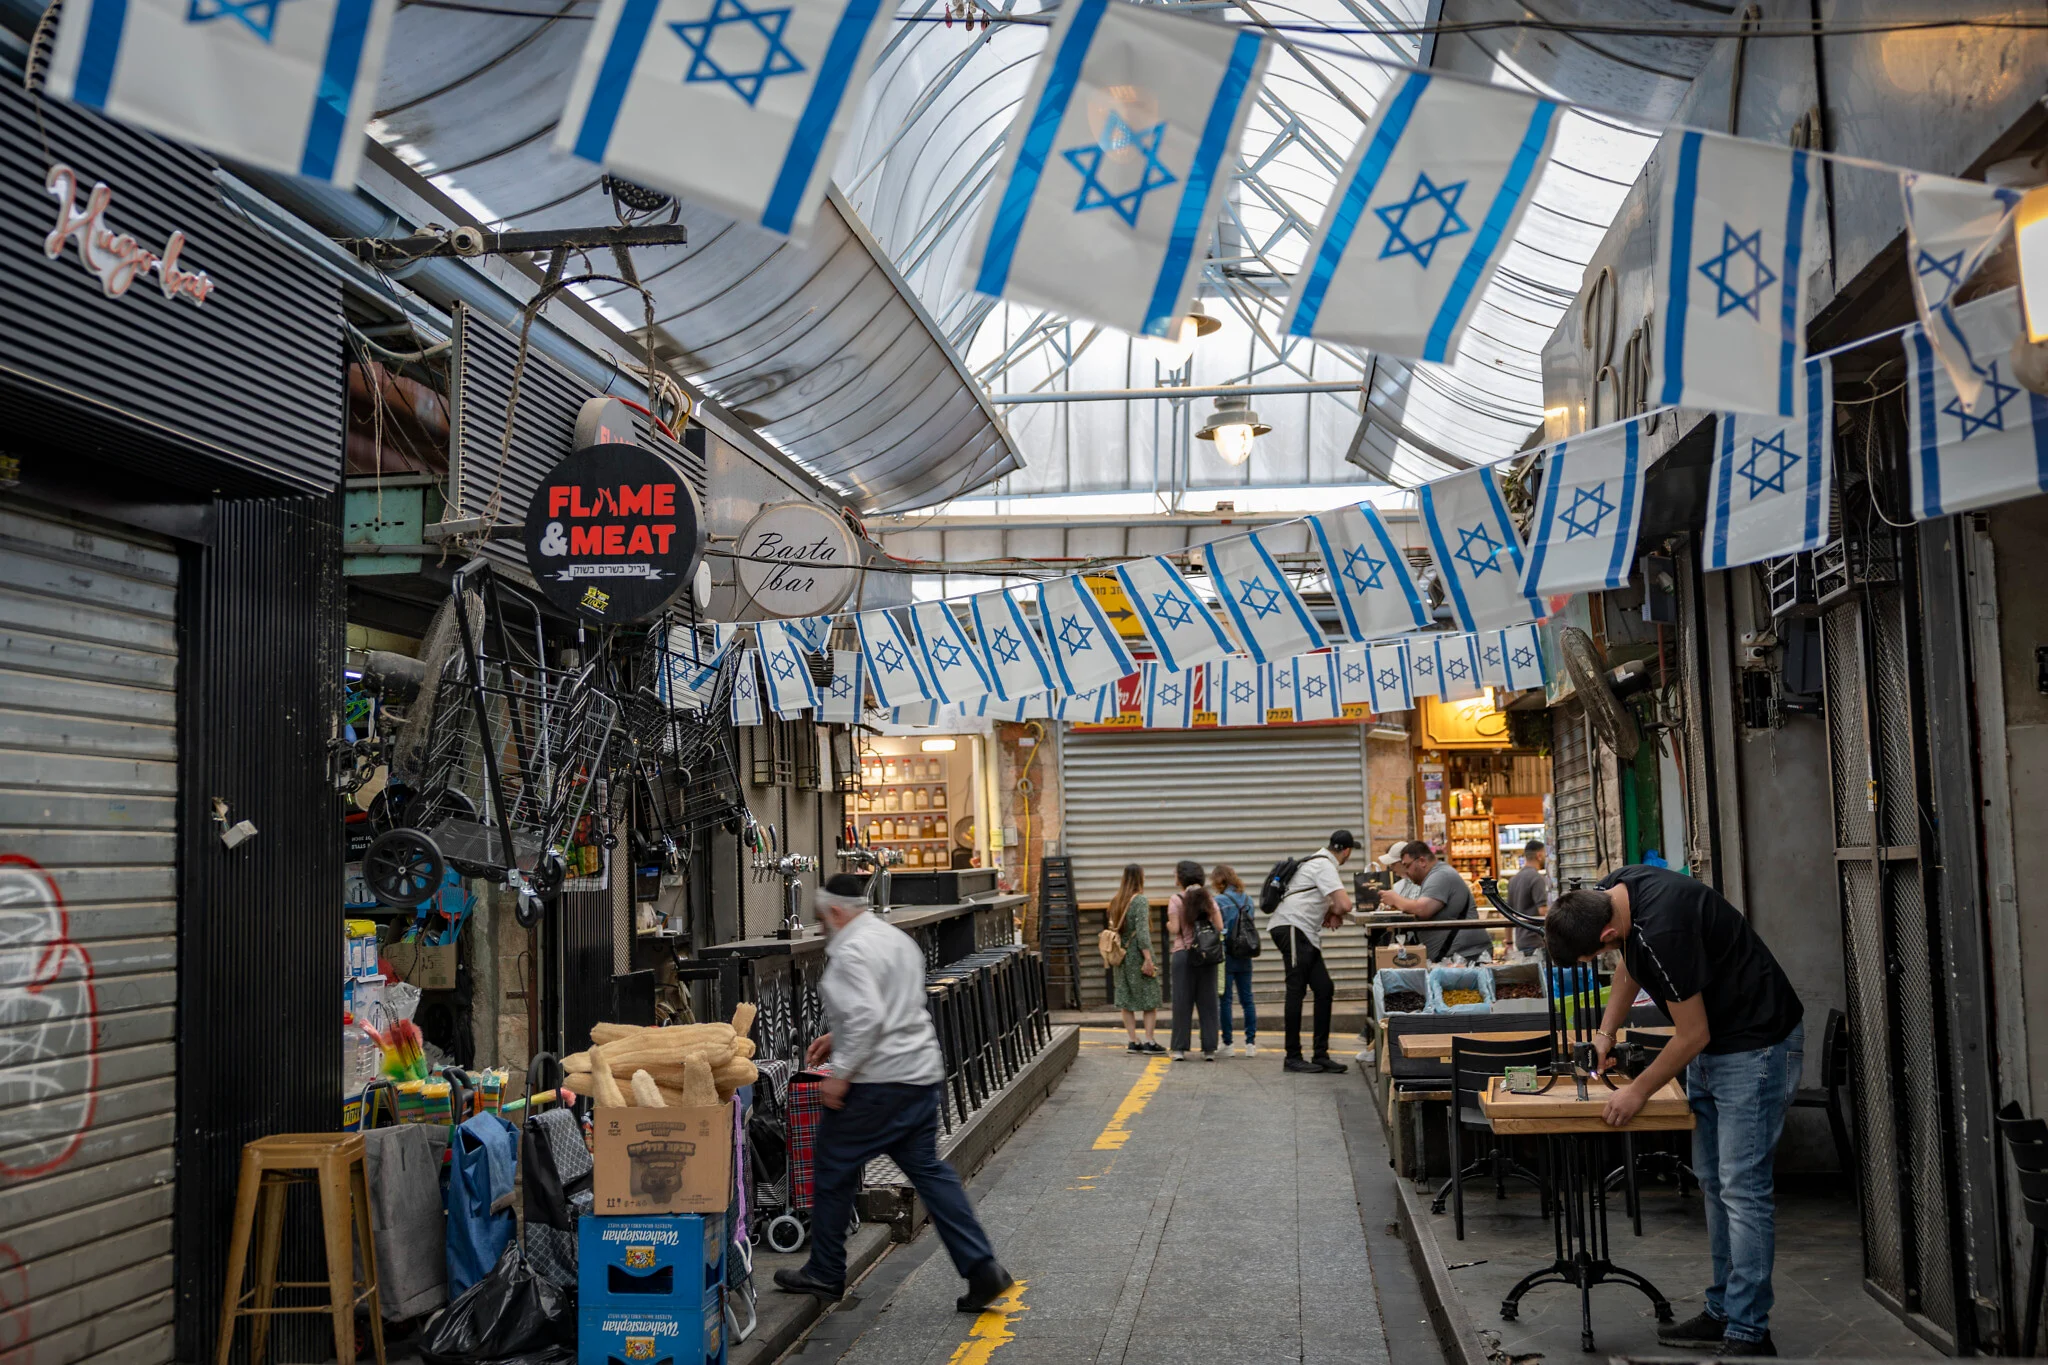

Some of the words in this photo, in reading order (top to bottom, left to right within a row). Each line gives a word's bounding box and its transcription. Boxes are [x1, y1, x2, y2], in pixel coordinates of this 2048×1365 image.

[45, 165, 160, 298] Hugo
[160, 231, 214, 306] bar
[549, 483, 676, 518] FLAME
[751, 532, 836, 560] Basta
[573, 566, 594, 575] בשוק
[598, 565, 625, 574] בשרים
[628, 564, 646, 573] גריל
[761, 562, 815, 592] bar
[602, 1228, 679, 1246] Weihenstephan
[602, 1318, 679, 1337] Weihenstephan
